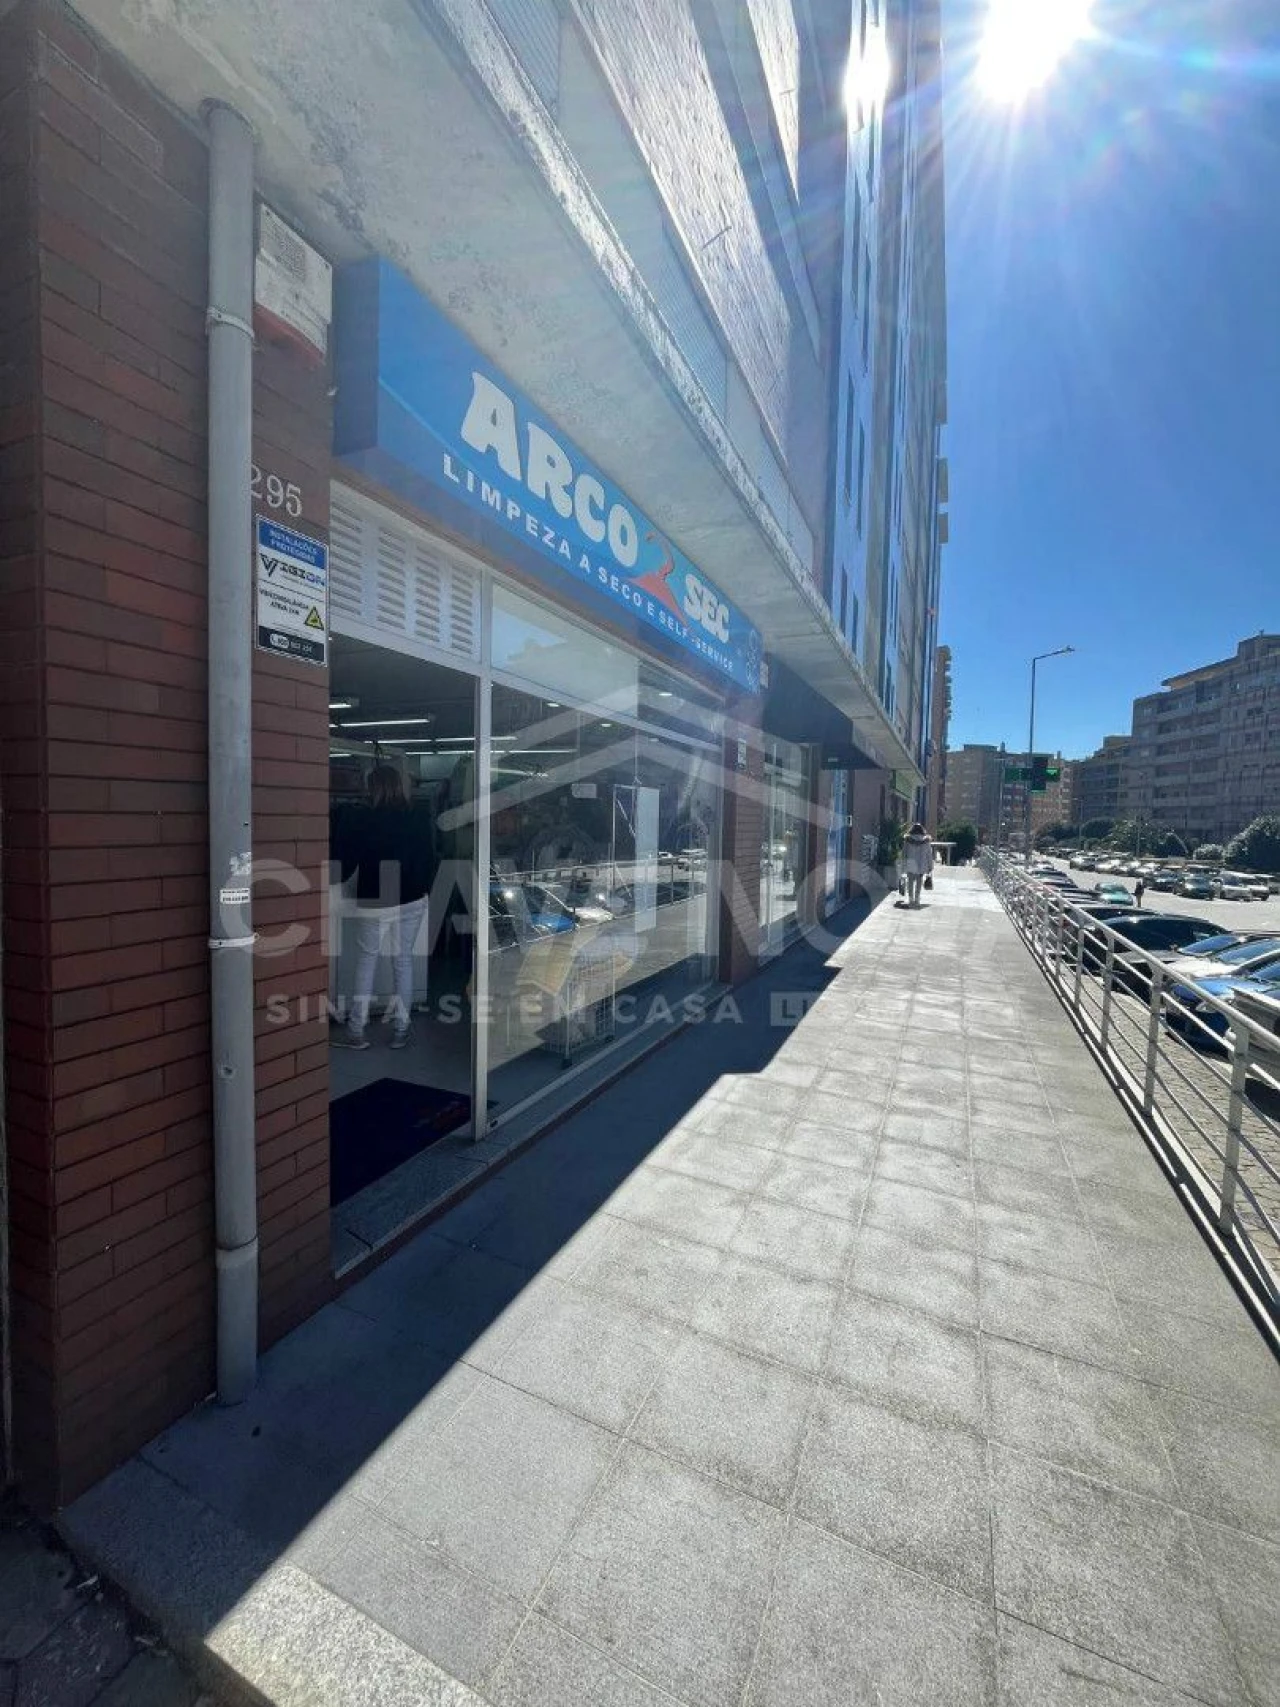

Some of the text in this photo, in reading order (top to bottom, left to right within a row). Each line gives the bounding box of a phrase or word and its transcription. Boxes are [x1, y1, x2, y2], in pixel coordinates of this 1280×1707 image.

[443, 452, 571, 560] LIMPEZA
[579, 554, 592, 574] A
[598, 568, 643, 607] SECO
[647, 601, 655, 617] E
[461, 371, 638, 567] ARCO
[684, 573, 730, 643] SEC
